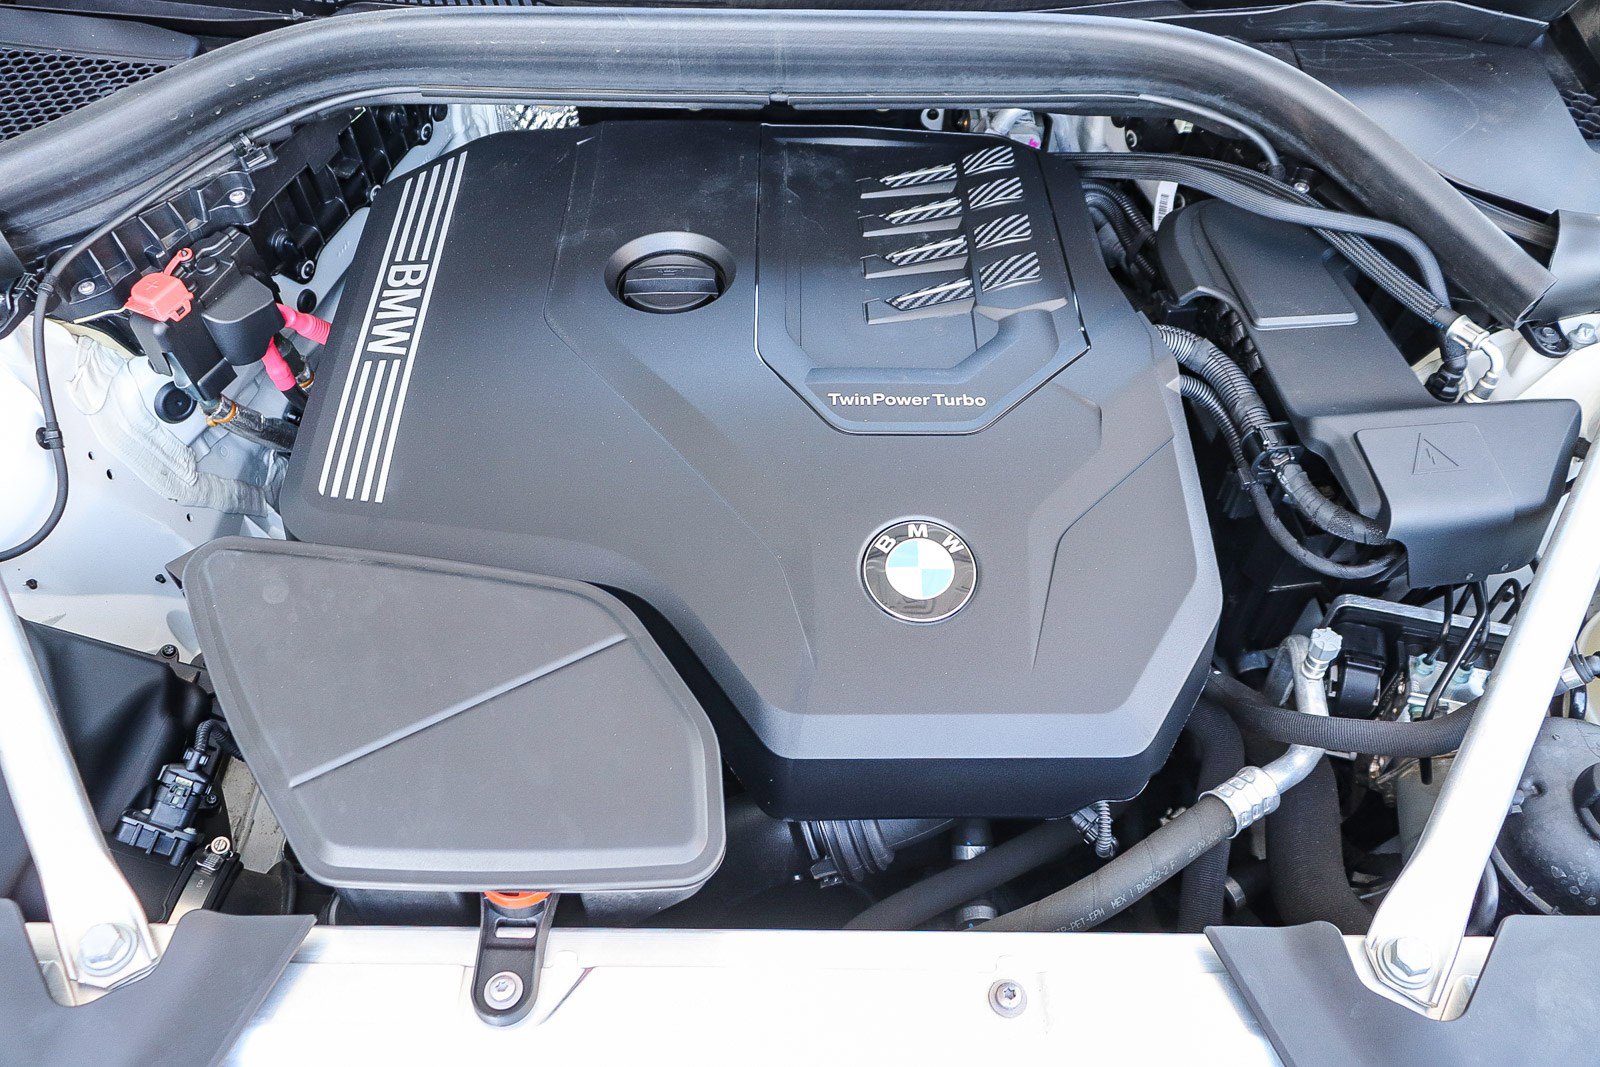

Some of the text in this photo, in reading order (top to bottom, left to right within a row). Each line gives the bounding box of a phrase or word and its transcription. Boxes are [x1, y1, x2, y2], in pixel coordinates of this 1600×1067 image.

[366, 263, 430, 355] BMW
[932, 393, 987, 407] Turbo
[874, 523, 965, 554] BMW
[1111, 894, 1127, 909] MEX
